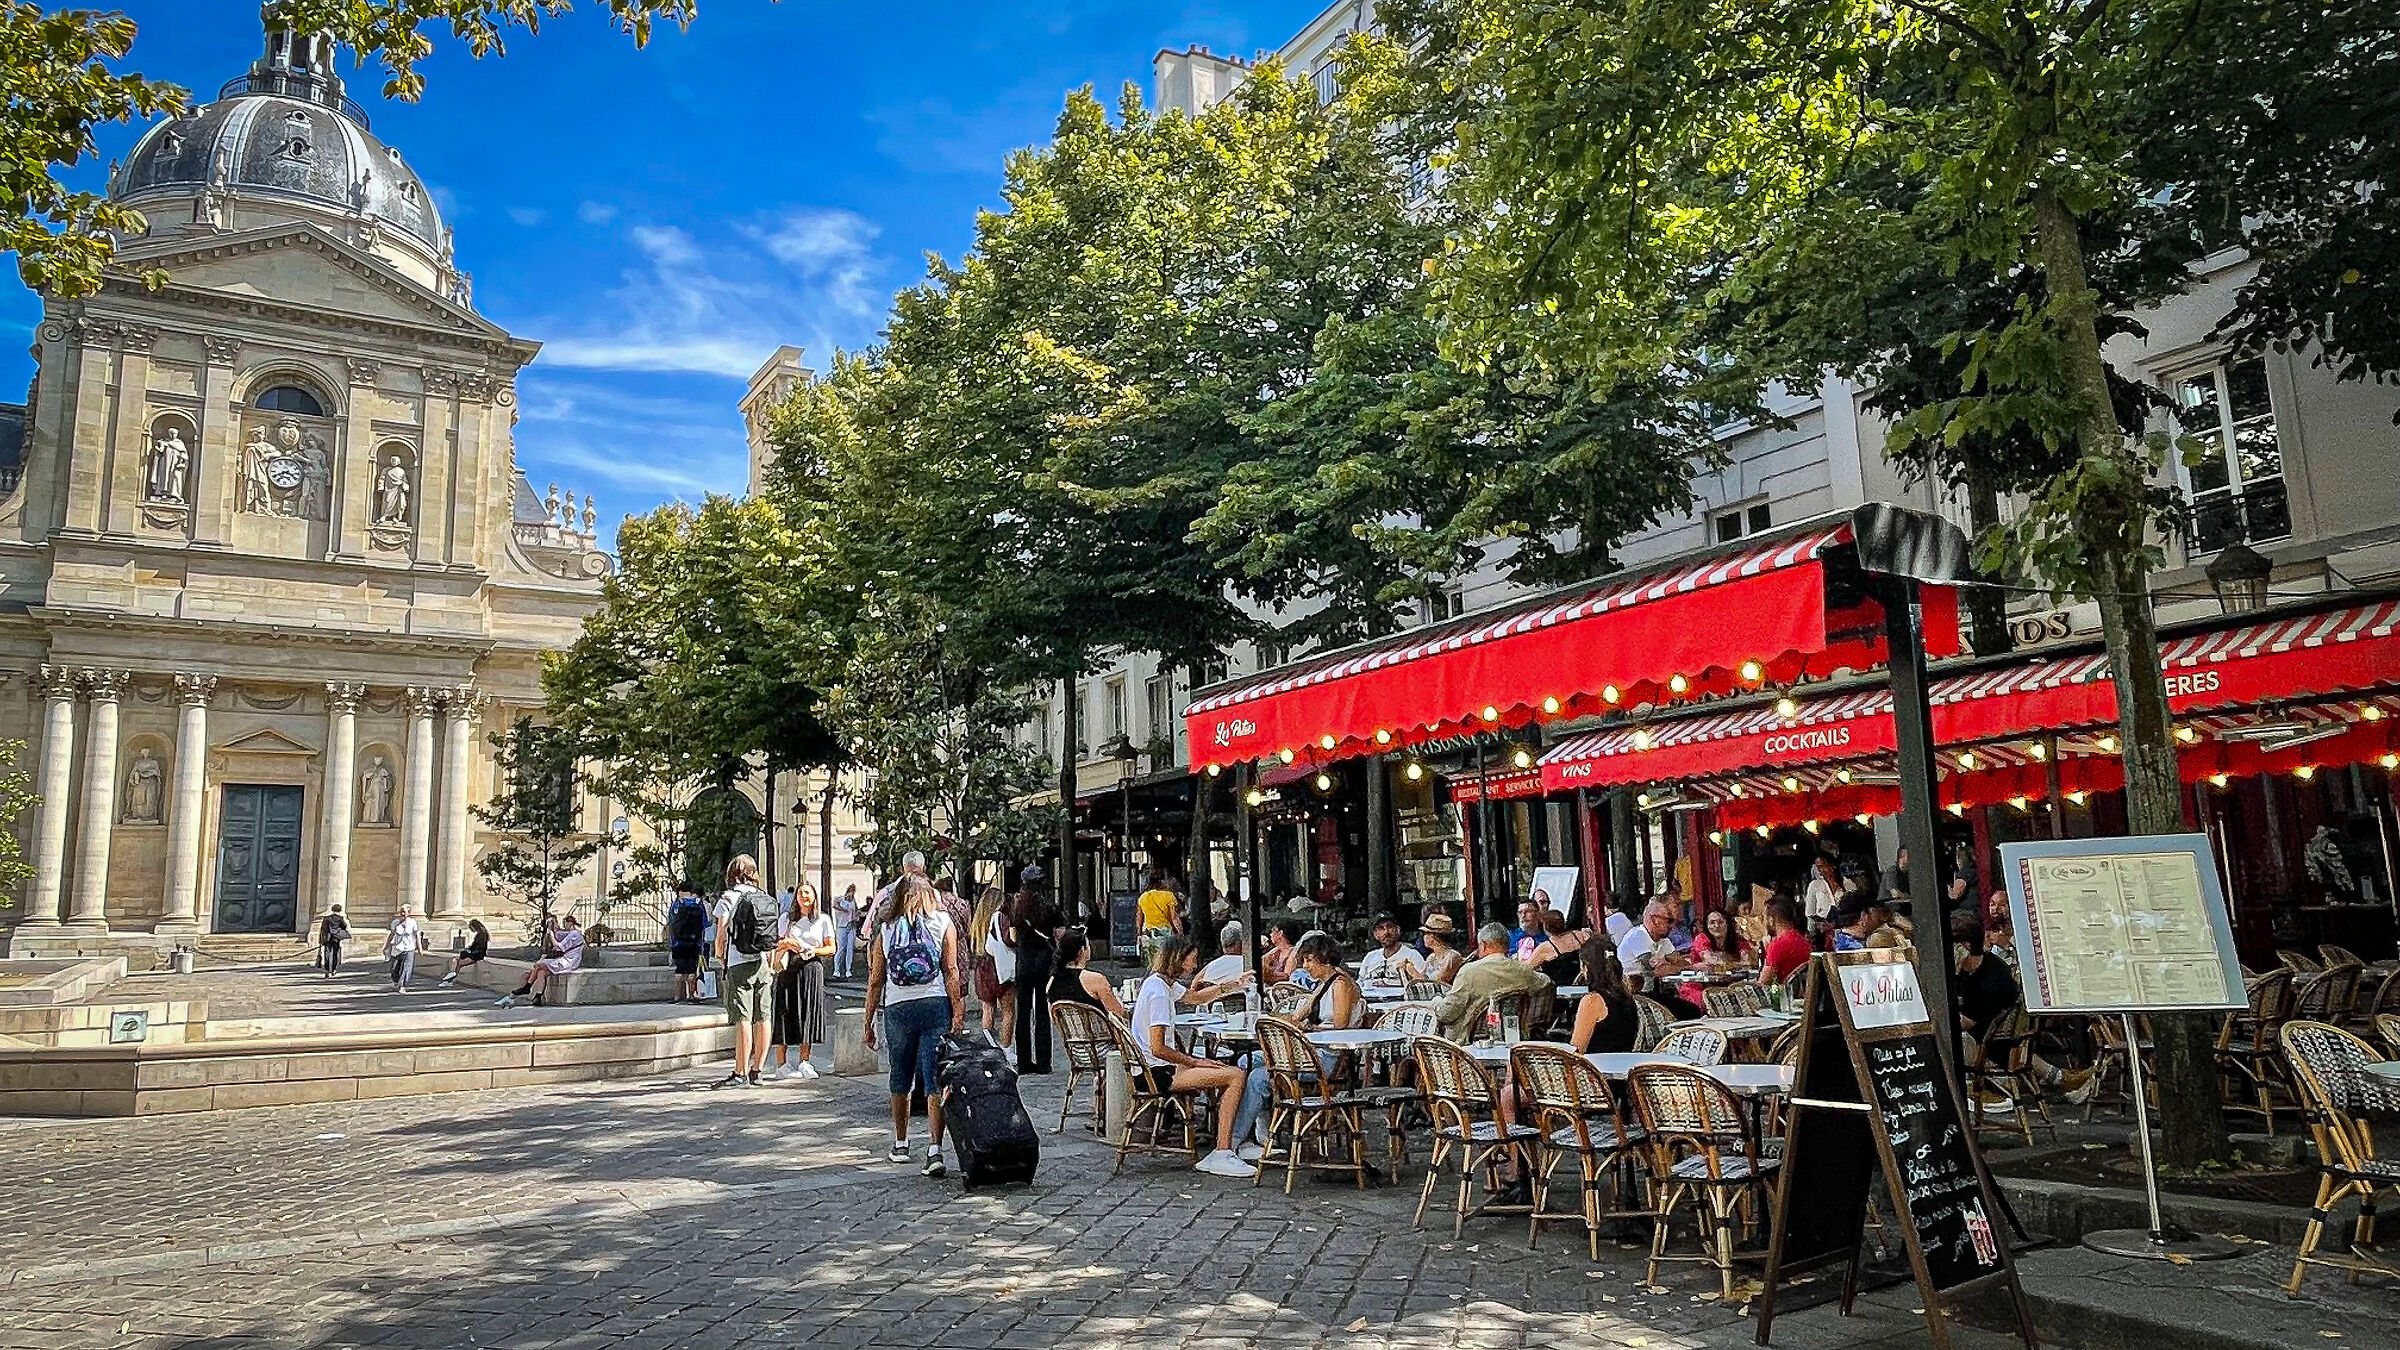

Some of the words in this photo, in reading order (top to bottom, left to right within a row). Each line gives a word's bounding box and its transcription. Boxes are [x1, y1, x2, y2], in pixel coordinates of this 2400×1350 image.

[1214, 721, 1230, 747] Les
[1764, 727, 1850, 753] COCKTAILS
[1562, 762, 1591, 778] VINS
[1851, 977, 1875, 1007] Les
[1877, 975, 1914, 1004] Patios
